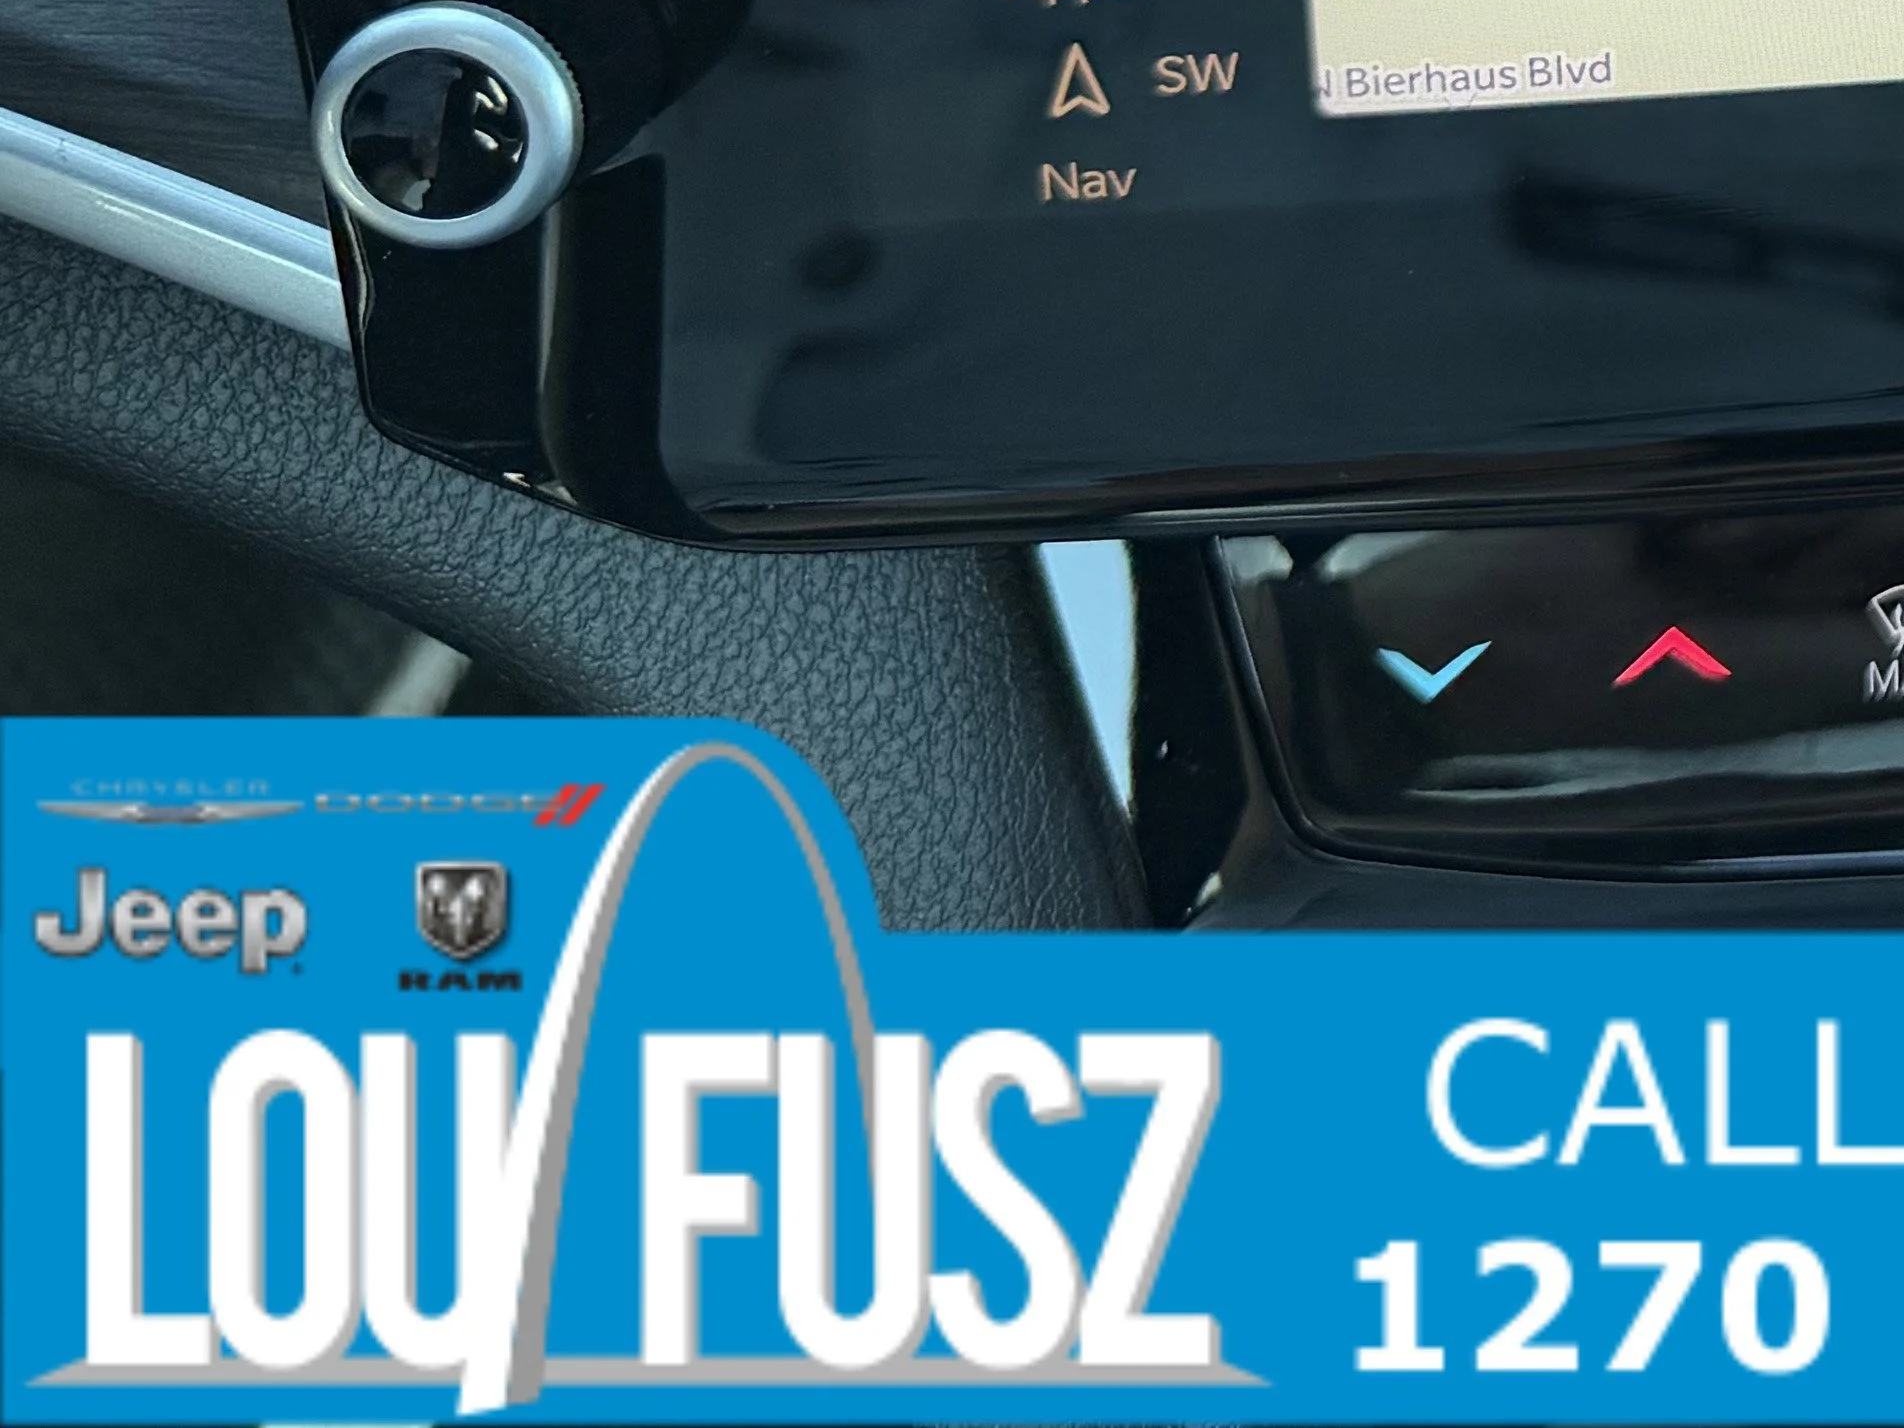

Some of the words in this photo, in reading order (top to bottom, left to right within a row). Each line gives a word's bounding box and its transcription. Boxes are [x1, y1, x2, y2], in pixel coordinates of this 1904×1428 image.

[1151, 50, 1241, 97] SW
[1346, 62, 1517, 98] Bierhaus
[1528, 51, 1612, 88] Blvd
[1039, 161, 1138, 203] Nav
